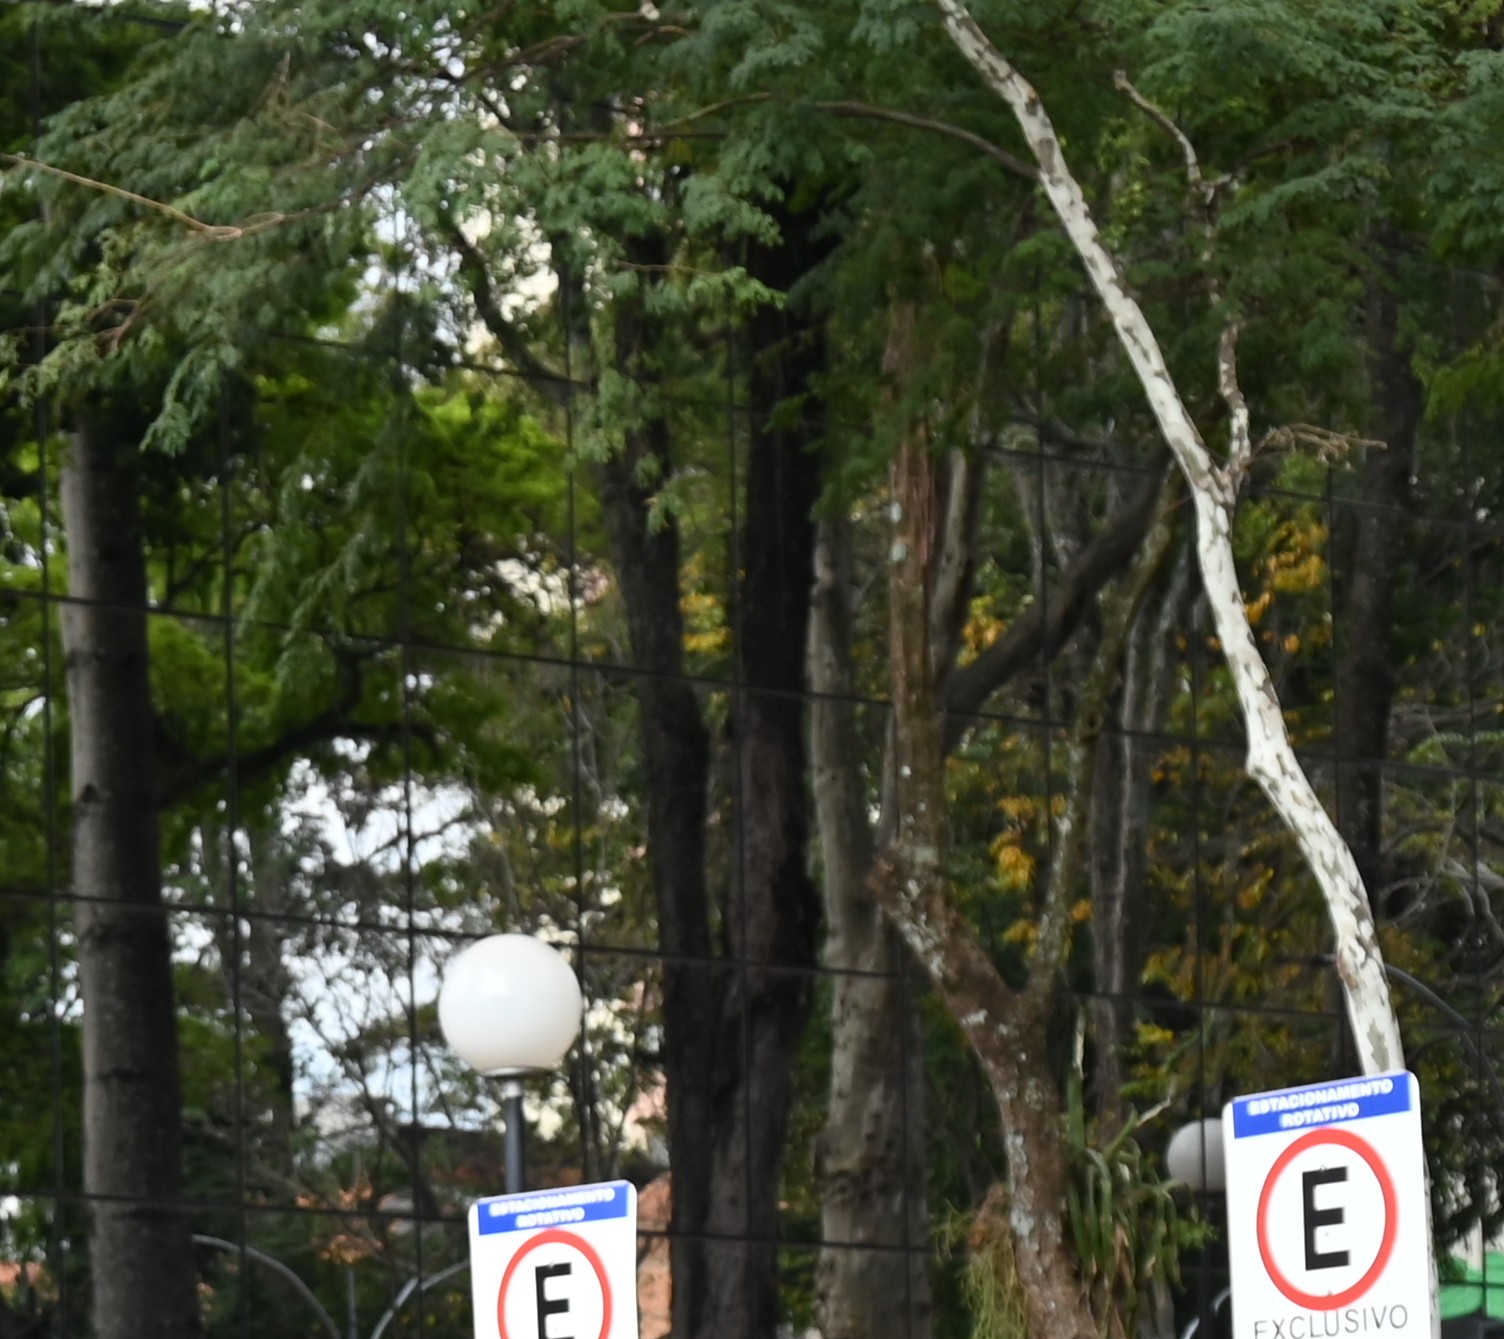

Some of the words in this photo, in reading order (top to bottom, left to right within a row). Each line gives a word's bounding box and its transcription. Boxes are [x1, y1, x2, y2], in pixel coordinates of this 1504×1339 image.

[1247, 1078, 1394, 1116] ESTACIONAMENTO
[1279, 1102, 1360, 1128] ROTATIVO
[490, 1187, 616, 1217] ESTACIONAMENTO
[515, 1206, 586, 1228] ROTATIVO
[1302, 1166, 1351, 1271] E
